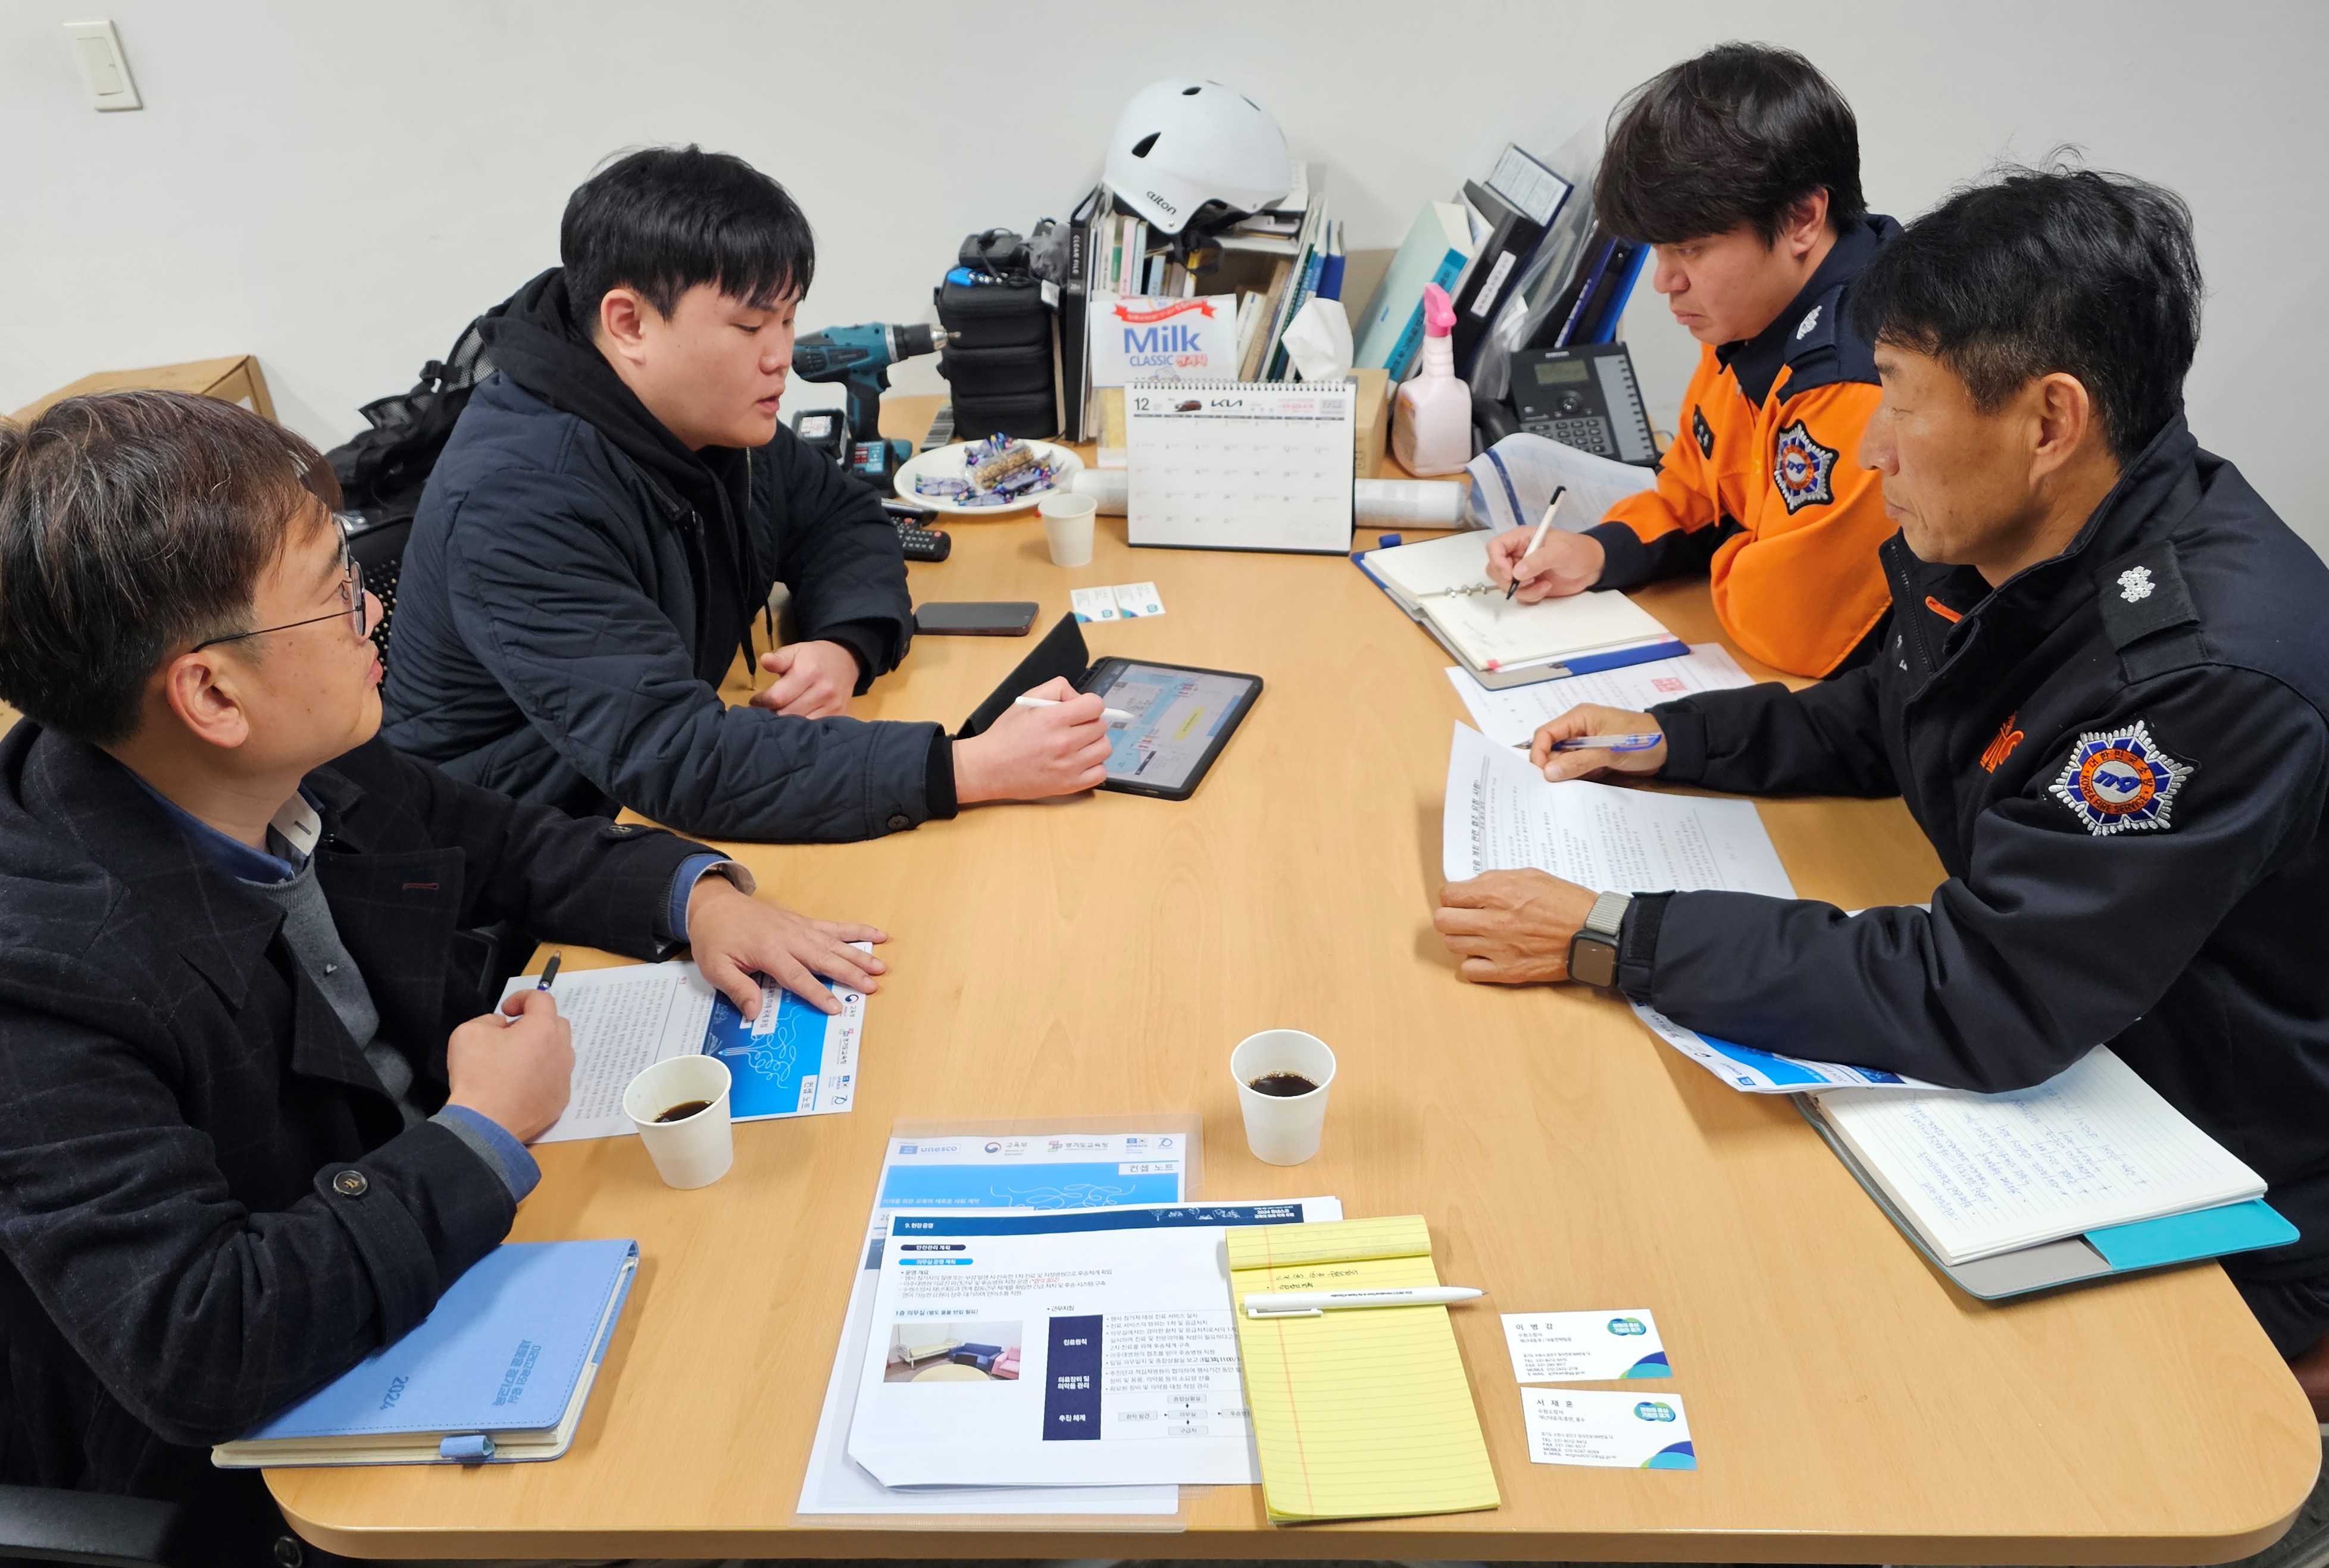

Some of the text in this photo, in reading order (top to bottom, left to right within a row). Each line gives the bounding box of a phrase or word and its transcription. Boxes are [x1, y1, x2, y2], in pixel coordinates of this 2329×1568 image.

[1124, 324, 1201, 353] Milk
[1130, 355, 1173, 366] CLASSIC
[1134, 398, 1149, 411] 12
[2081, 775, 2149, 813] KOREA FIRE SERVICE
[2092, 770, 2141, 793] 119
[760, 1019, 768, 1028] 포럼
[762, 1009, 771, 1018] 국제
[840, 1038, 849, 1065] 경기도교육청
[801, 1081, 814, 1109] 컨셉 노트
[379, 1376, 409, 1410] 2024
